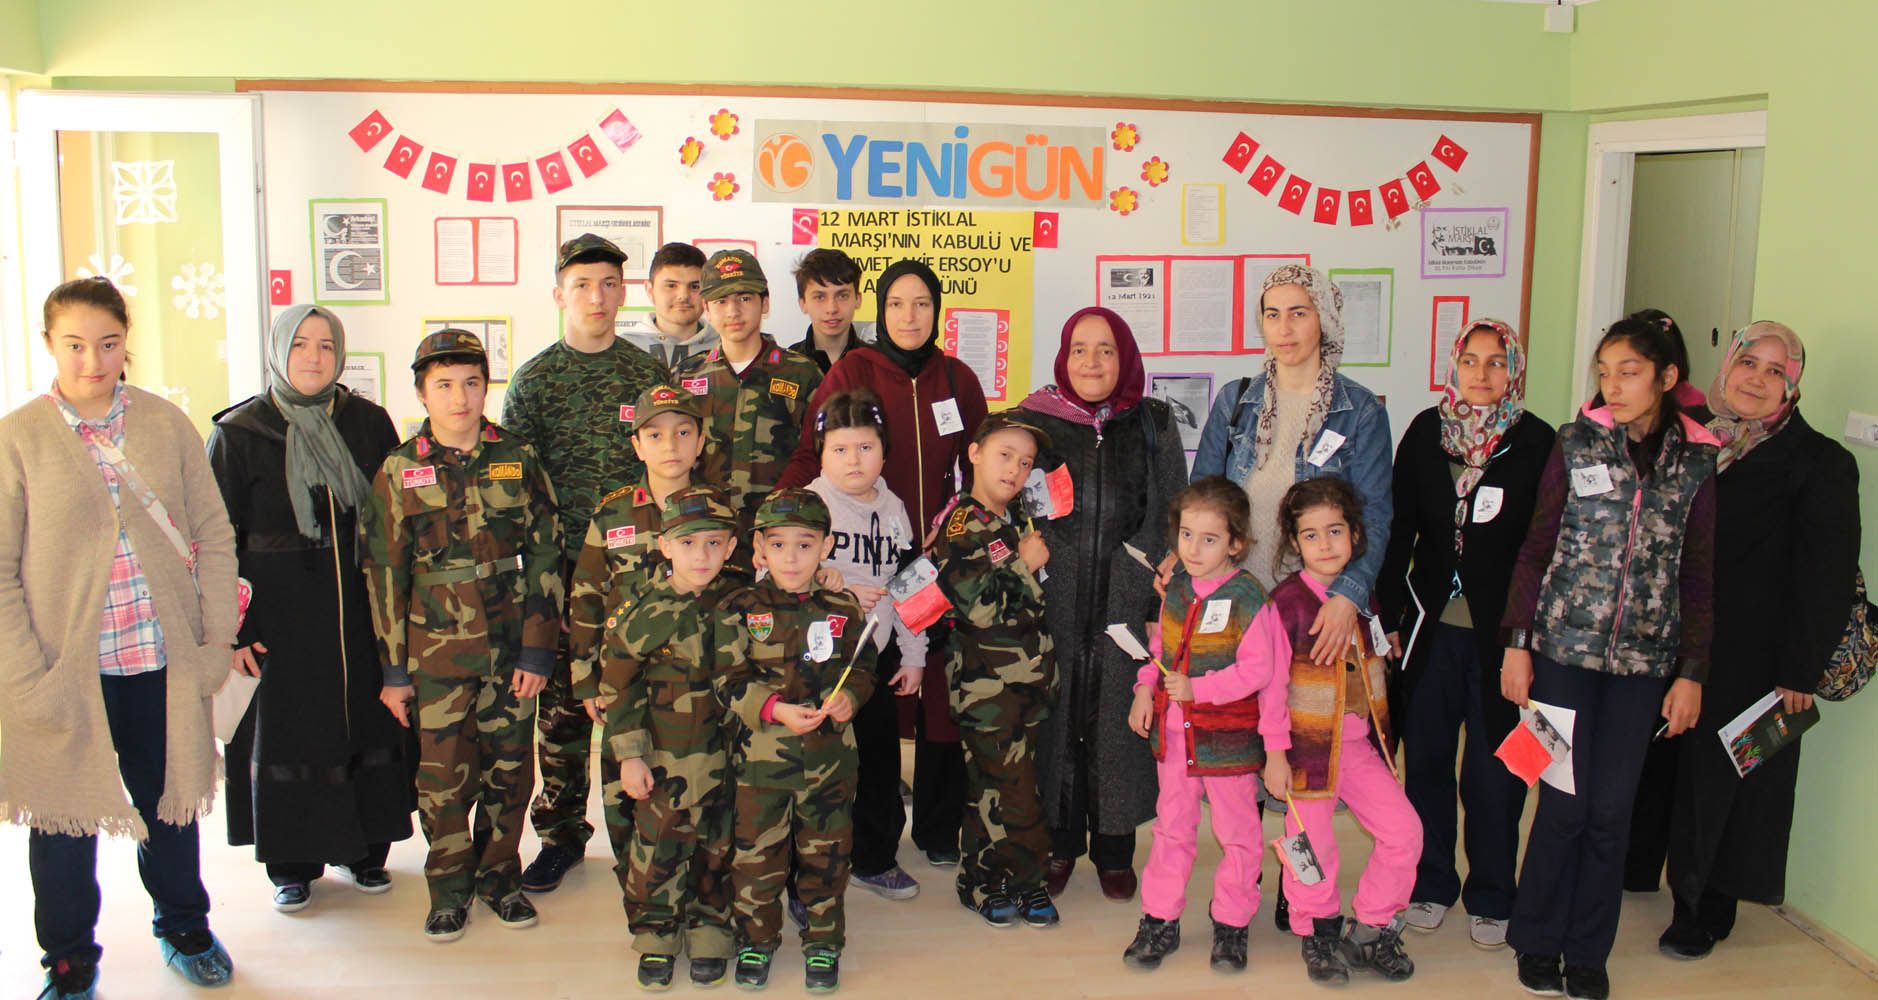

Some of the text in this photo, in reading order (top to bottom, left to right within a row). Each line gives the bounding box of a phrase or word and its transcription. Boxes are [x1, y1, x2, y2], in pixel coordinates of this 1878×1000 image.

[822, 125, 1104, 200] YENİGÜN
[820, 209, 977, 226] 12 MART İSTİKLAL
[831, 232, 1032, 252] MARŞI'NIN KABULÜ VE
[939, 256, 1011, 272] ERSOY'U
[940, 275, 977, 294] ÜNÜ
[827, 530, 901, 565] PINK
